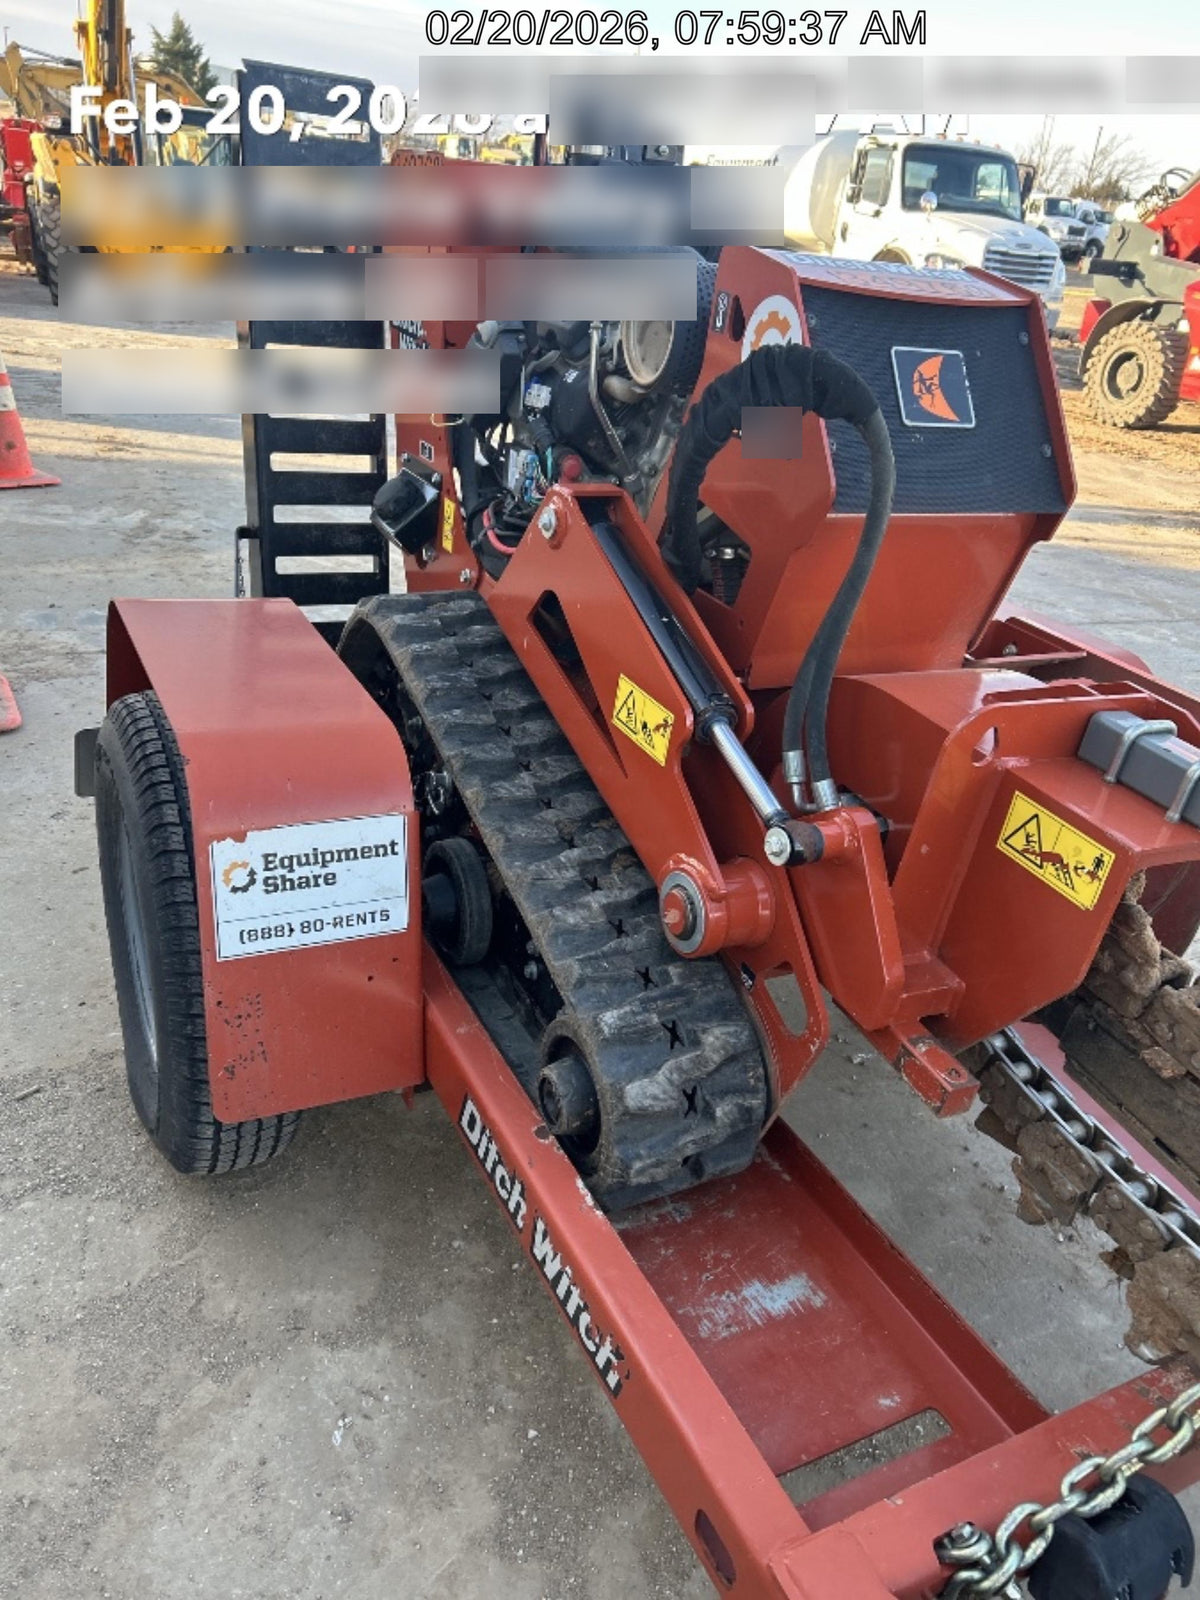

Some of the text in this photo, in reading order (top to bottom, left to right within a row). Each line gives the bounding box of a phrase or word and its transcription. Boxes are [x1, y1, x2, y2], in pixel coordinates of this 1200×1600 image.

[262, 839, 399, 873] Equipment
[262, 871, 337, 895] Share
[239, 909, 391, 945] (888) 80-RENTS
[459, 1095, 527, 1231] Ditch
